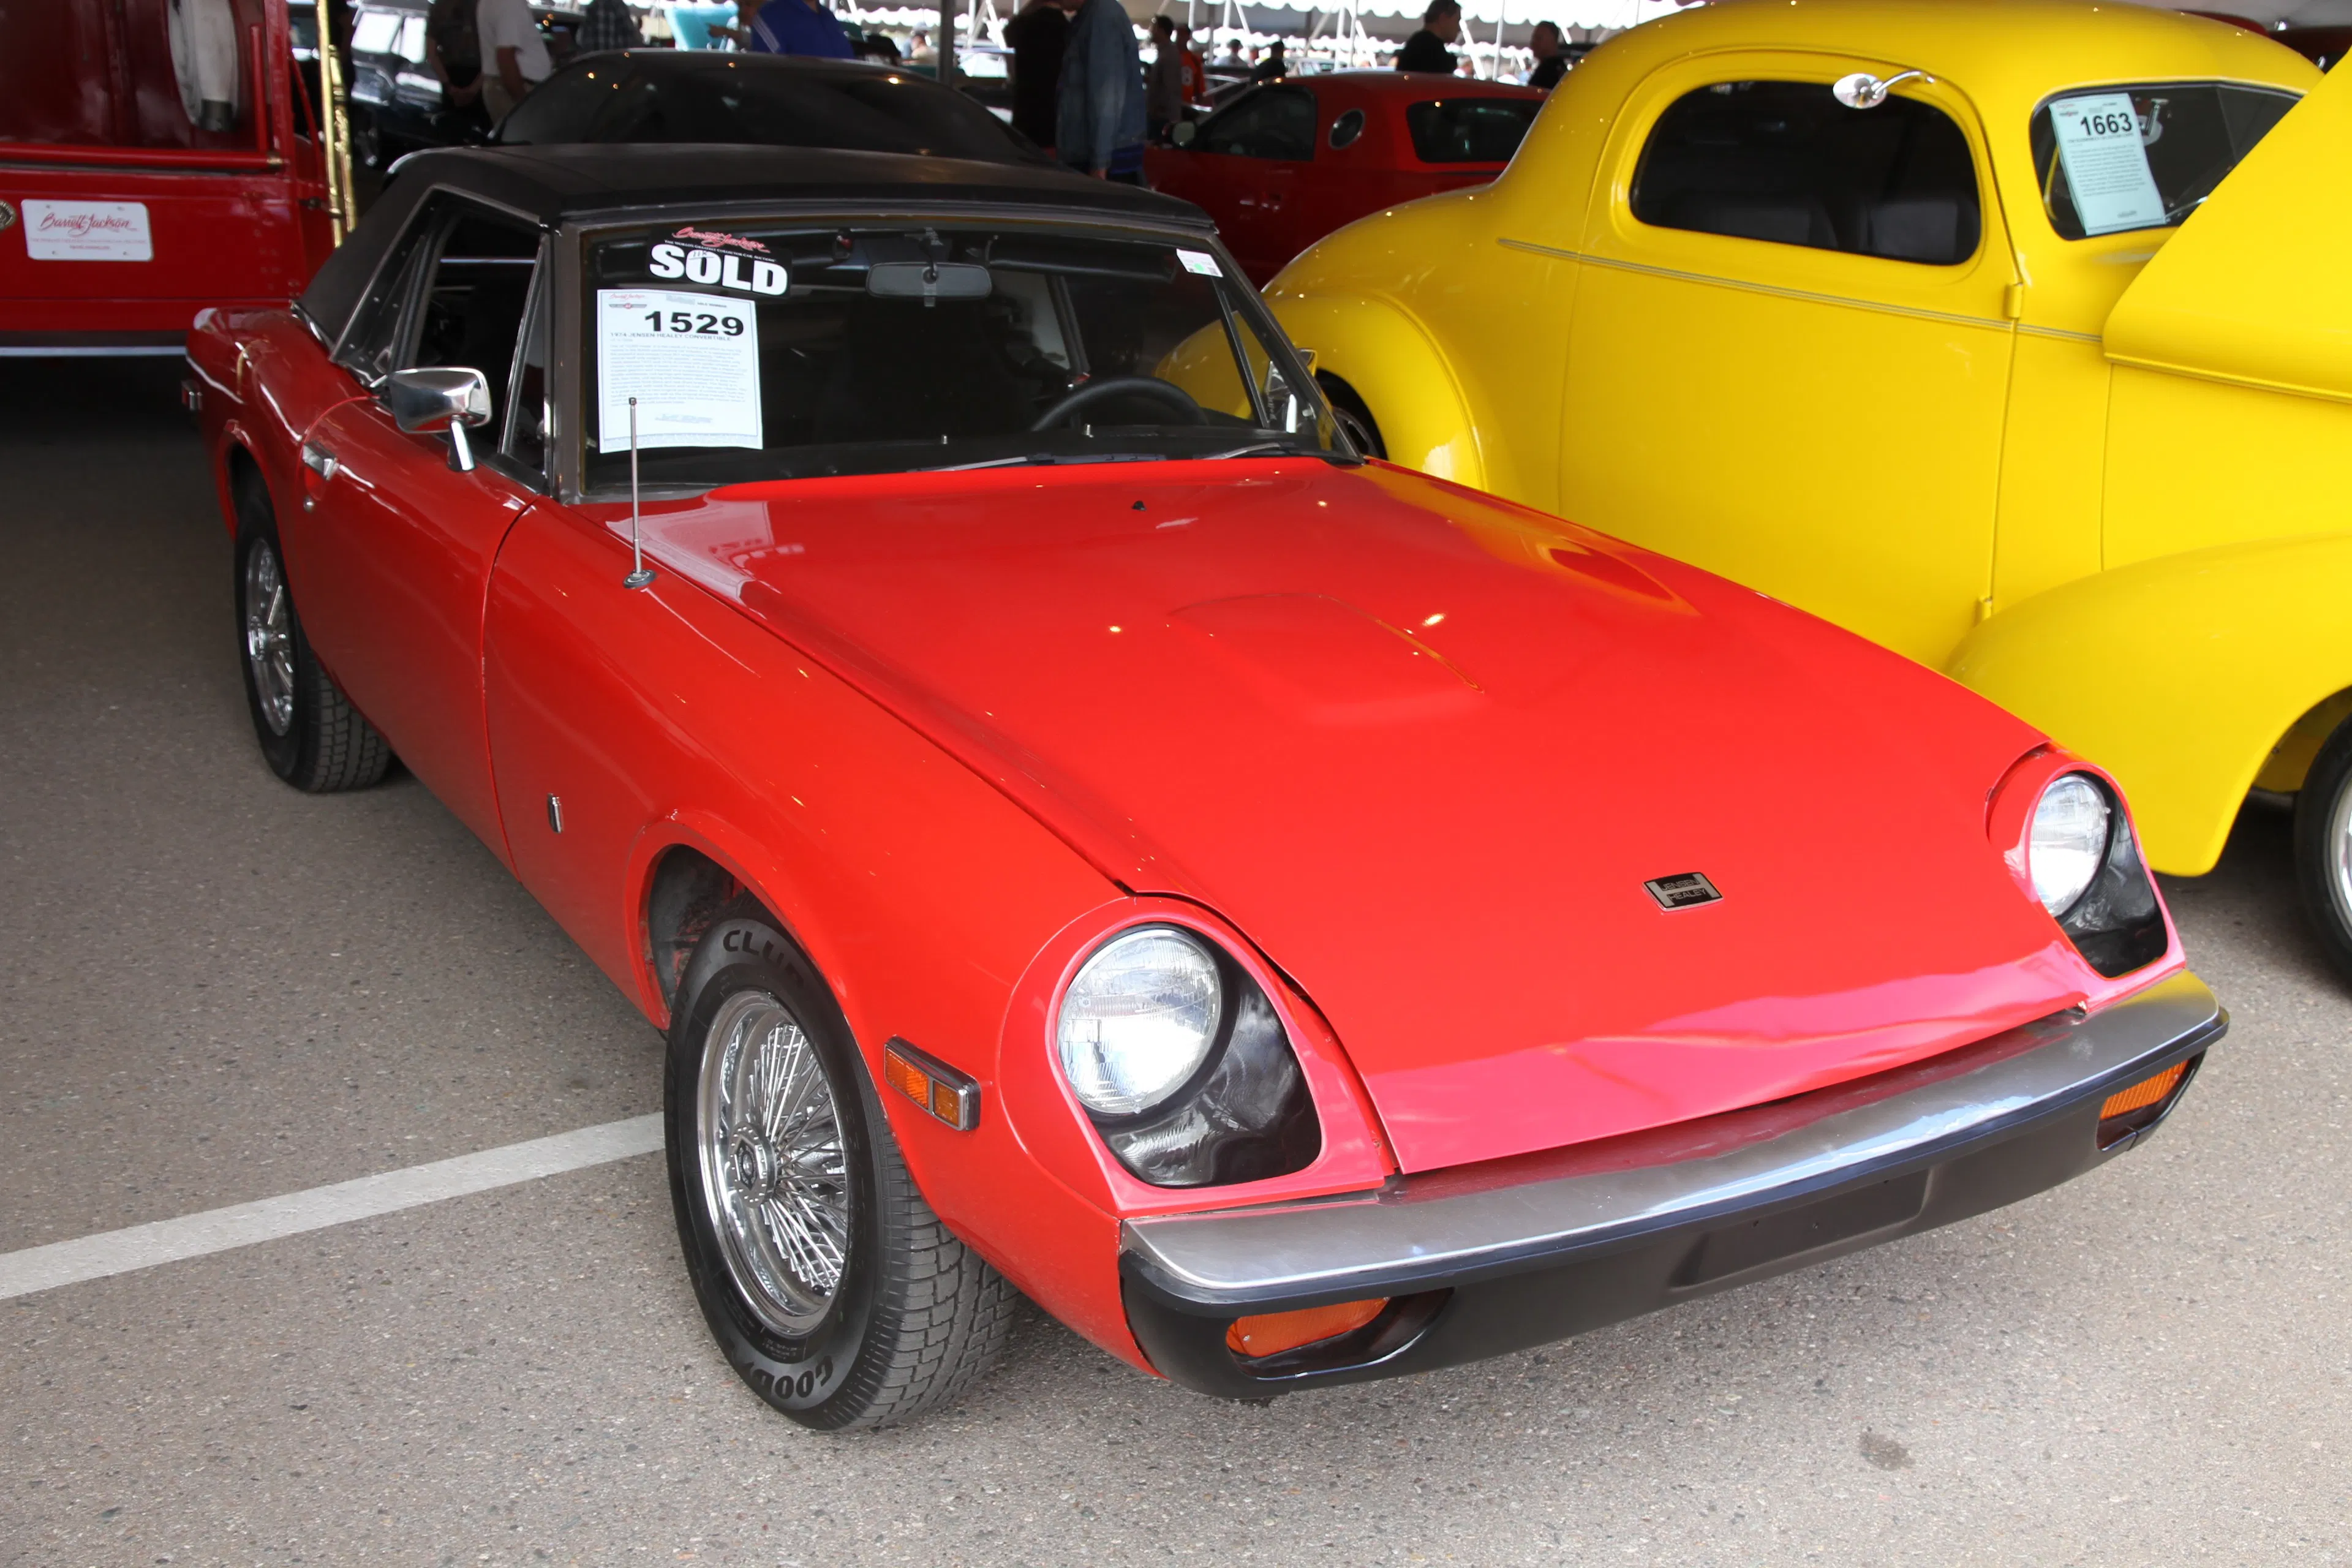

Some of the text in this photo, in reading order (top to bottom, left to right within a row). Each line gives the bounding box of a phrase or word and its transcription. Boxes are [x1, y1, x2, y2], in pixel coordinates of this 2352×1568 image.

[2080, 112, 2133, 136] 1663
[37, 212, 138, 238] Barrett-Jackson
[649, 244, 788, 295] SOLD
[644, 311, 744, 336] 1529
[1662, 879, 1700, 891] JENSEN
[1668, 888, 1707, 900] HEALEY
